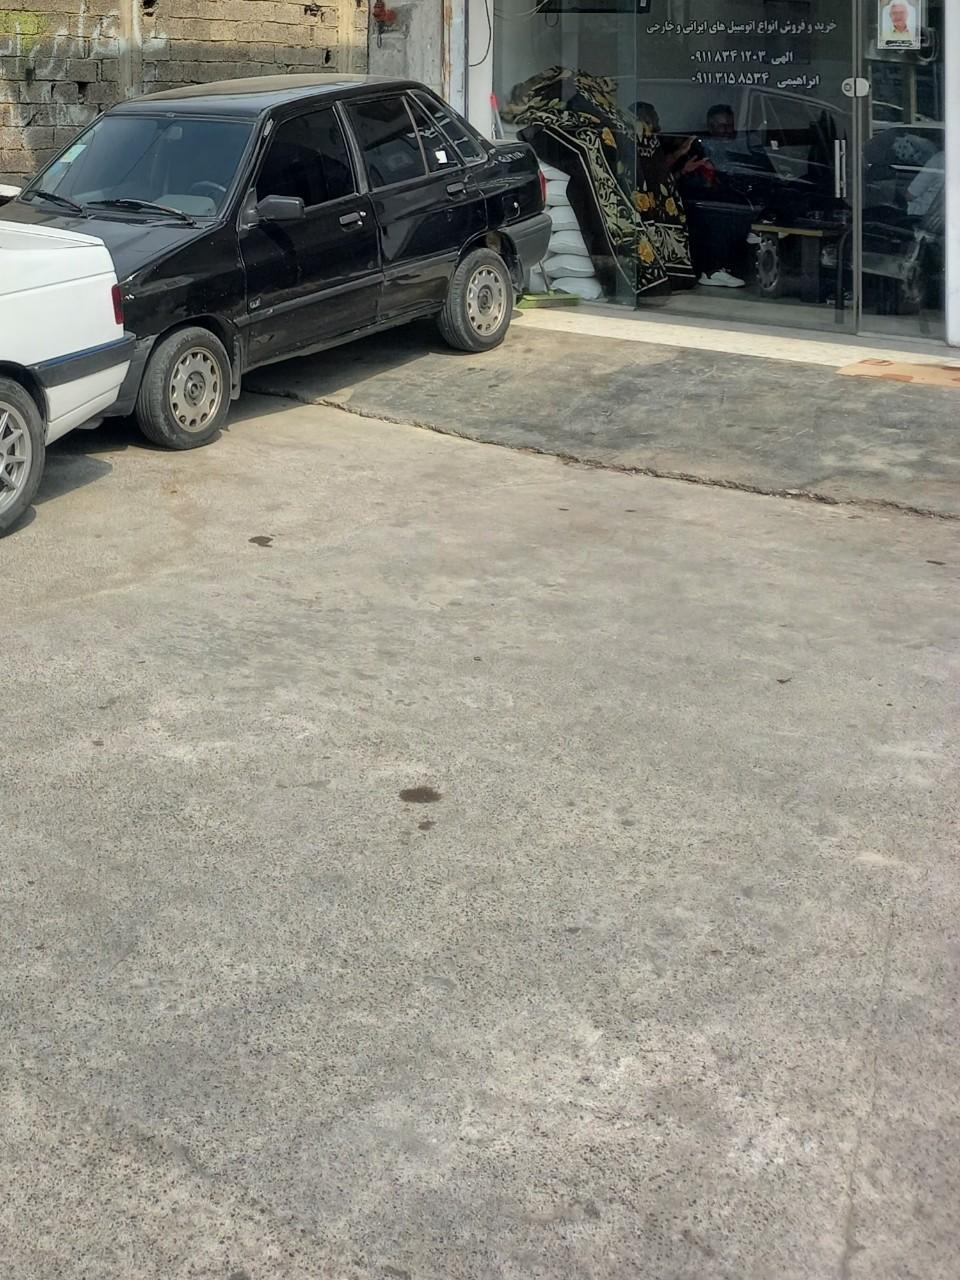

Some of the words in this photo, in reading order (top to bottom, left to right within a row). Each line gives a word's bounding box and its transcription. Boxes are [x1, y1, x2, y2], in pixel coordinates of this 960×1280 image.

[646, 21, 674, 34] خارجی
[676, 23, 681, 34] و
[683, 20, 707, 34] ایرانی
[709, 21, 726, 34] های
[757, 20, 778, 34] انواع
[780, 19, 805, 33] فروش
[807, 23, 813, 33] و
[814, 19, 837, 33] خرید
[691, 51, 711, 62] ۰۹۱۱
[771, 51, 793, 65] الهی
[691, 72, 711, 83] ۰۹۱۱
[777, 75, 820, 89] ابراهیمی
